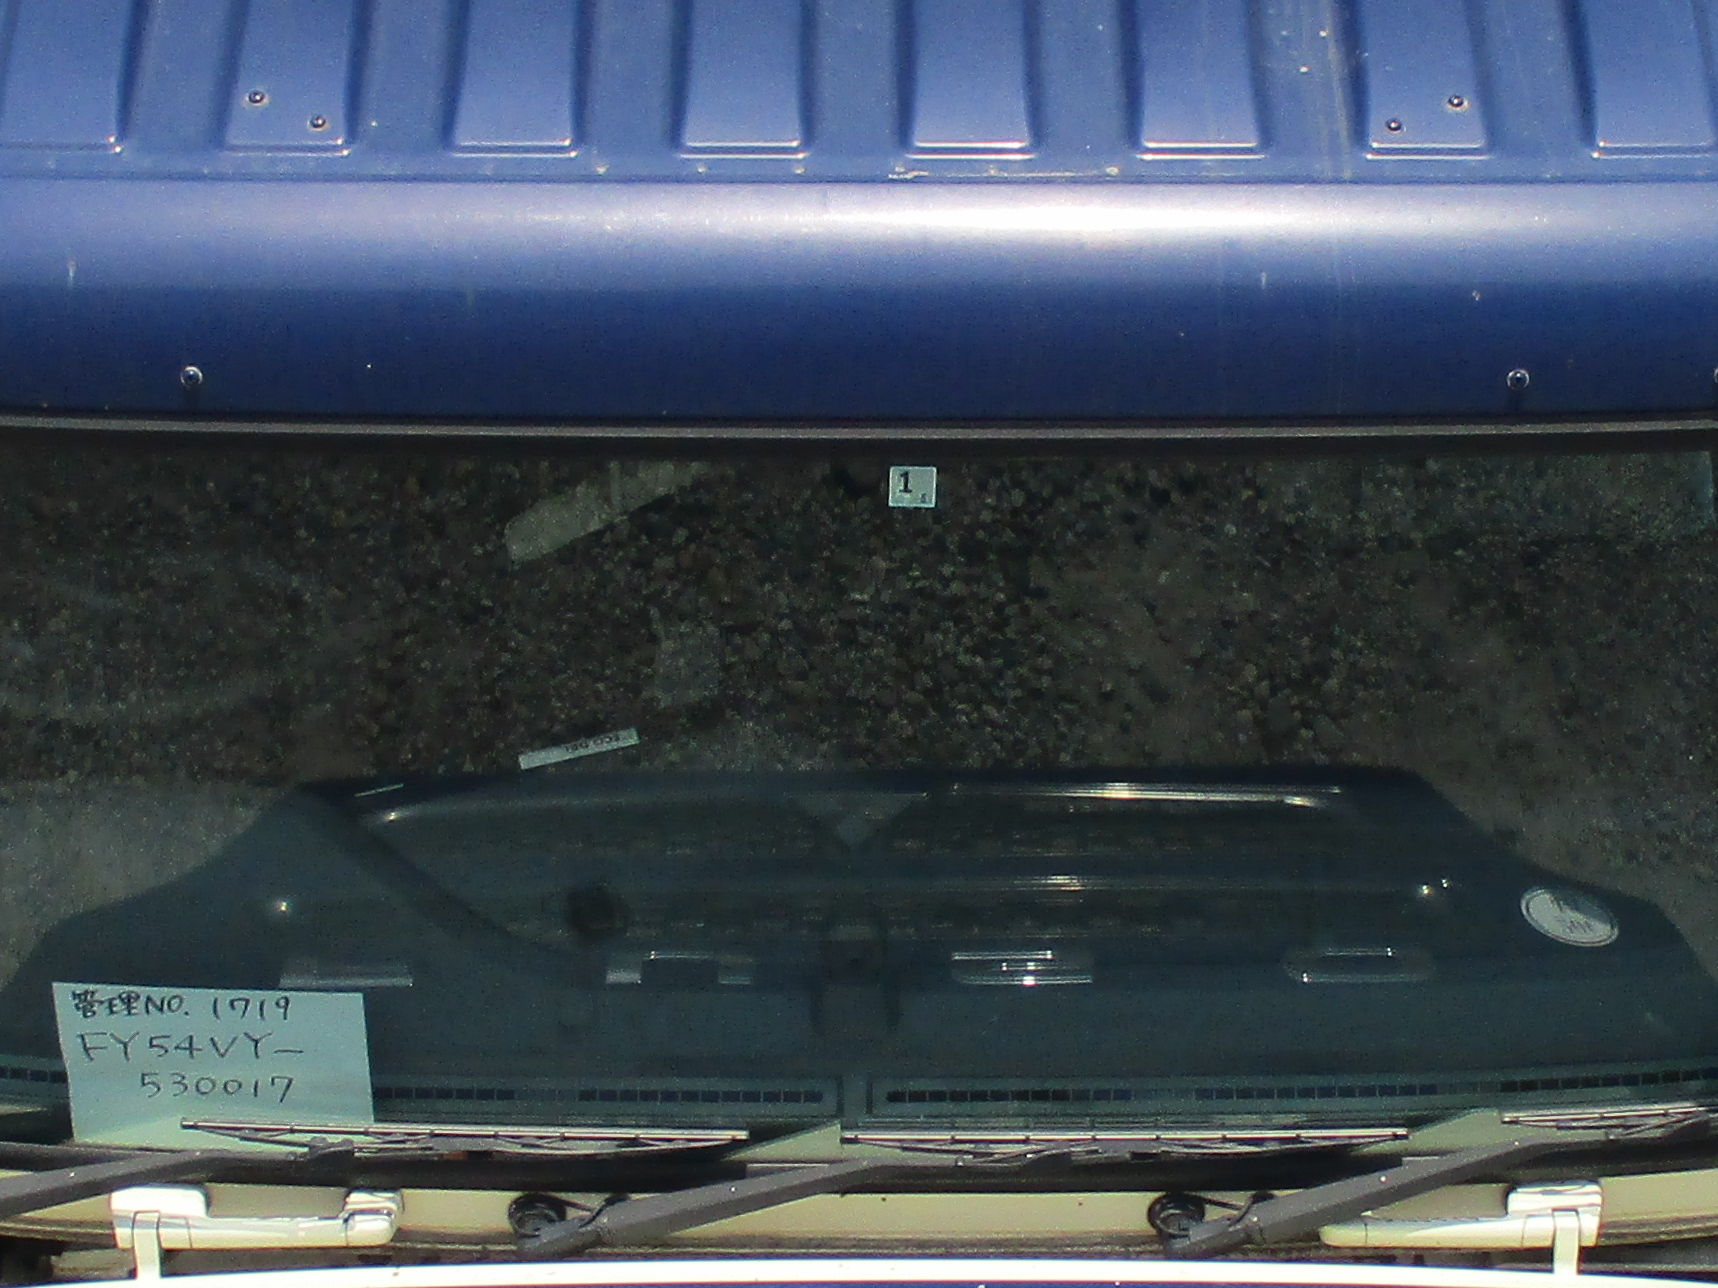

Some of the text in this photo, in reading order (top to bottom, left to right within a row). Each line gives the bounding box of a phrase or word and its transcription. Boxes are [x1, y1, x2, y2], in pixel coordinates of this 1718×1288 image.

[899, 471, 913, 493] 1
[213, 996, 292, 1021] 1719
[140, 1072, 294, 1103] 530017
